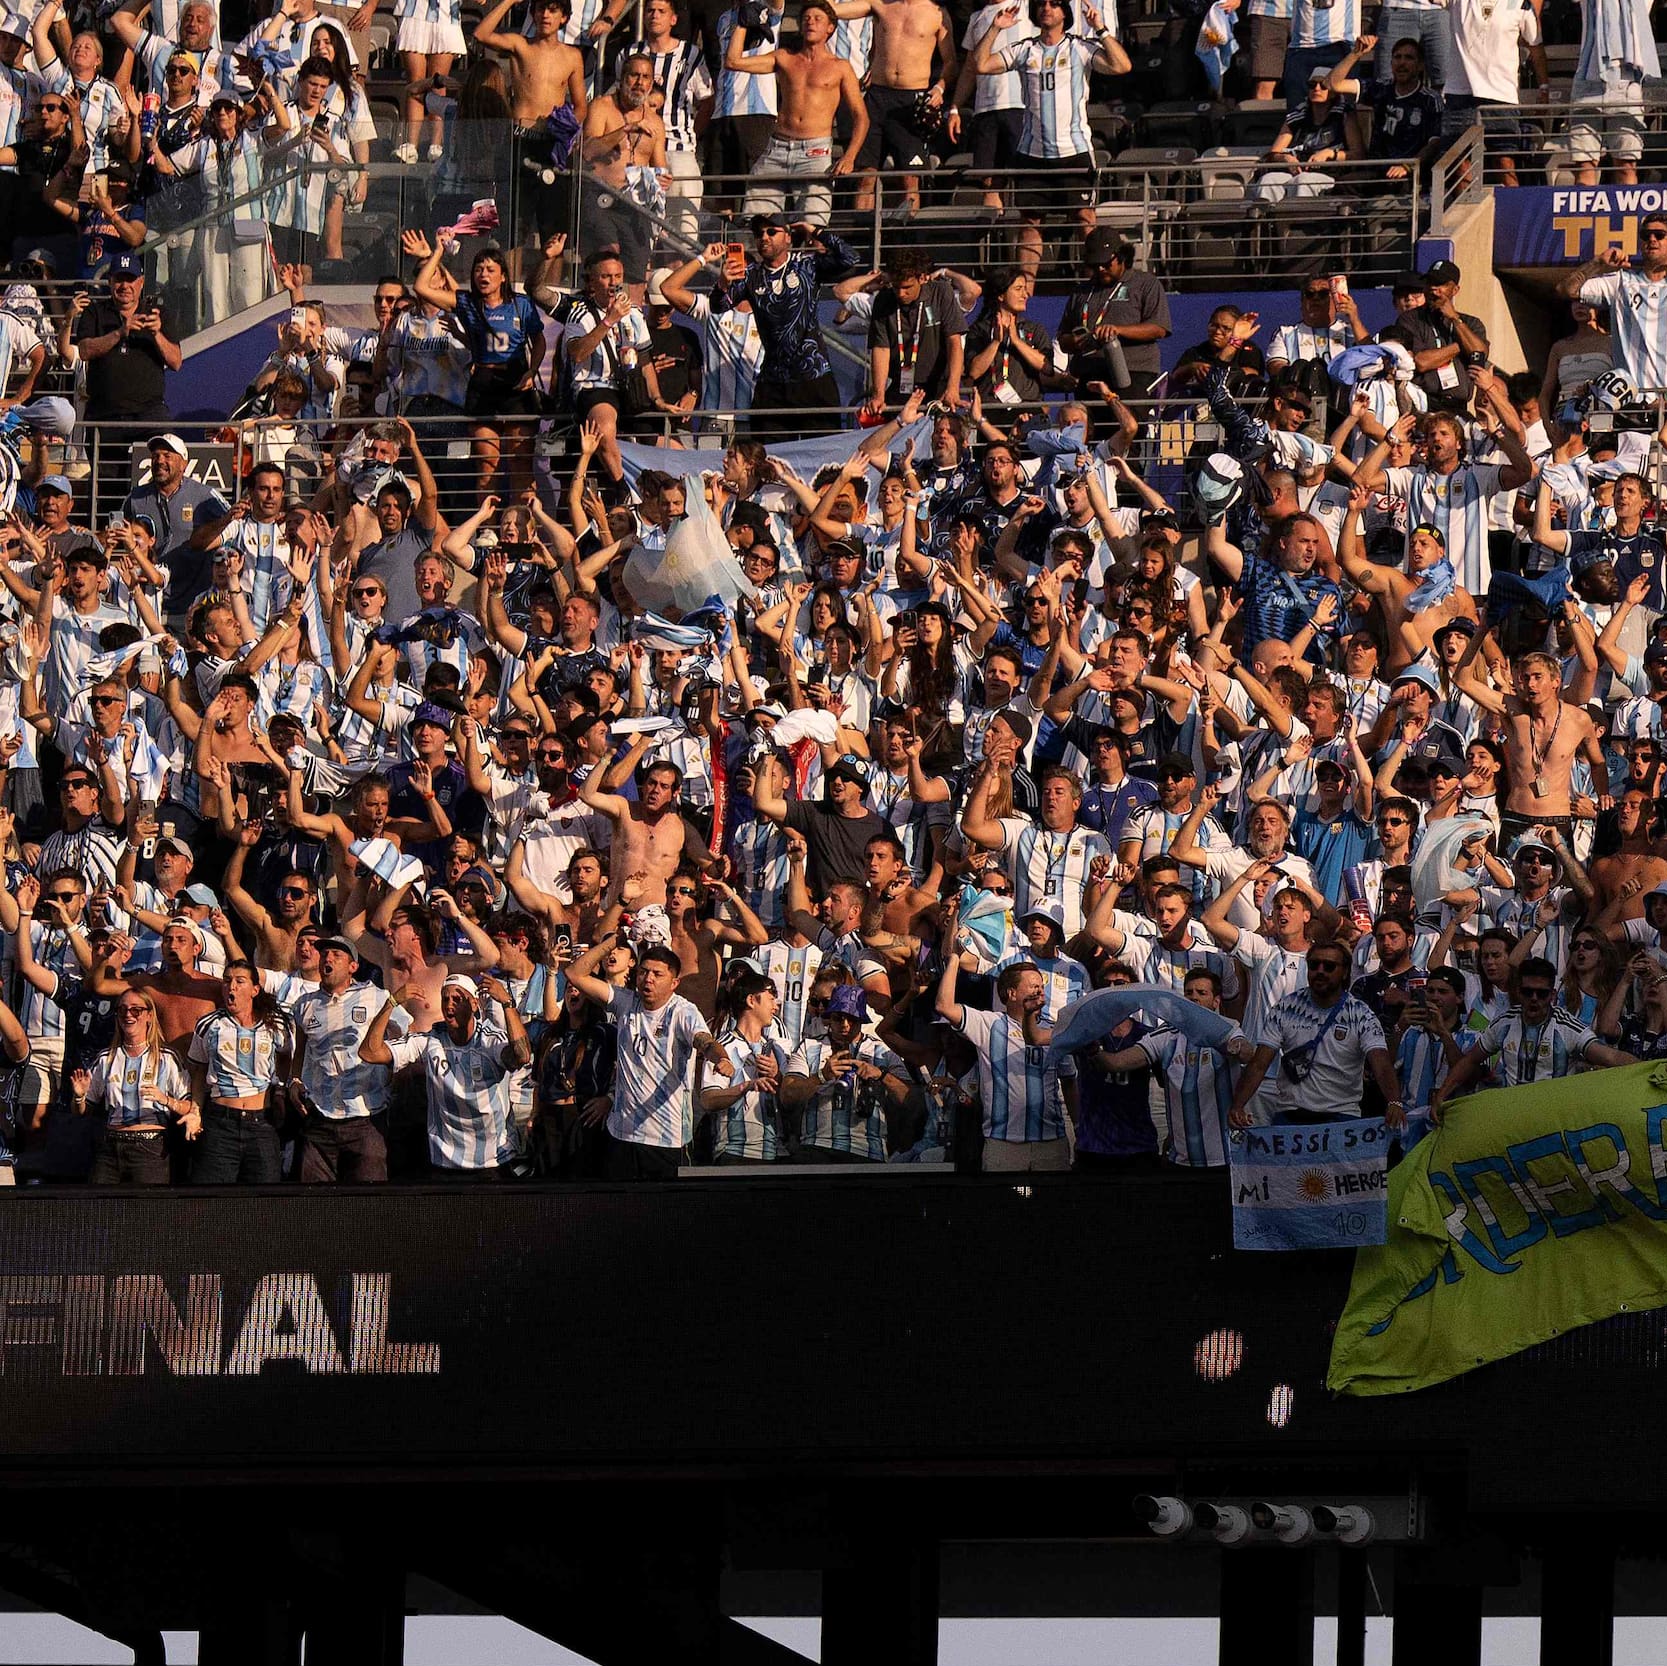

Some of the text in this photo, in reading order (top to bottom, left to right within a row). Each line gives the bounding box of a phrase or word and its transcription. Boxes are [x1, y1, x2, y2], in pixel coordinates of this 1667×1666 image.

[1039, 72, 1055, 92] 10
[1553, 190, 1612, 213] FIFA
[487, 333, 510, 352] 10
[139, 458, 227, 489] 24A
[872, 550, 885, 570] 10
[785, 980, 803, 1002] 10
[80, 1015, 92, 1035] 9
[633, 1036, 649, 1057] 10
[1026, 1047, 1043, 1067] 10
[433, 1056, 451, 1078] 19
[1519, 1060, 1533, 1082] 10
[1344, 1123, 1386, 1148] SOS
[1334, 1170, 1388, 1196] HEROE
[1334, 1211, 1367, 1237] 10
[0, 1272, 442, 1376] FINAL
